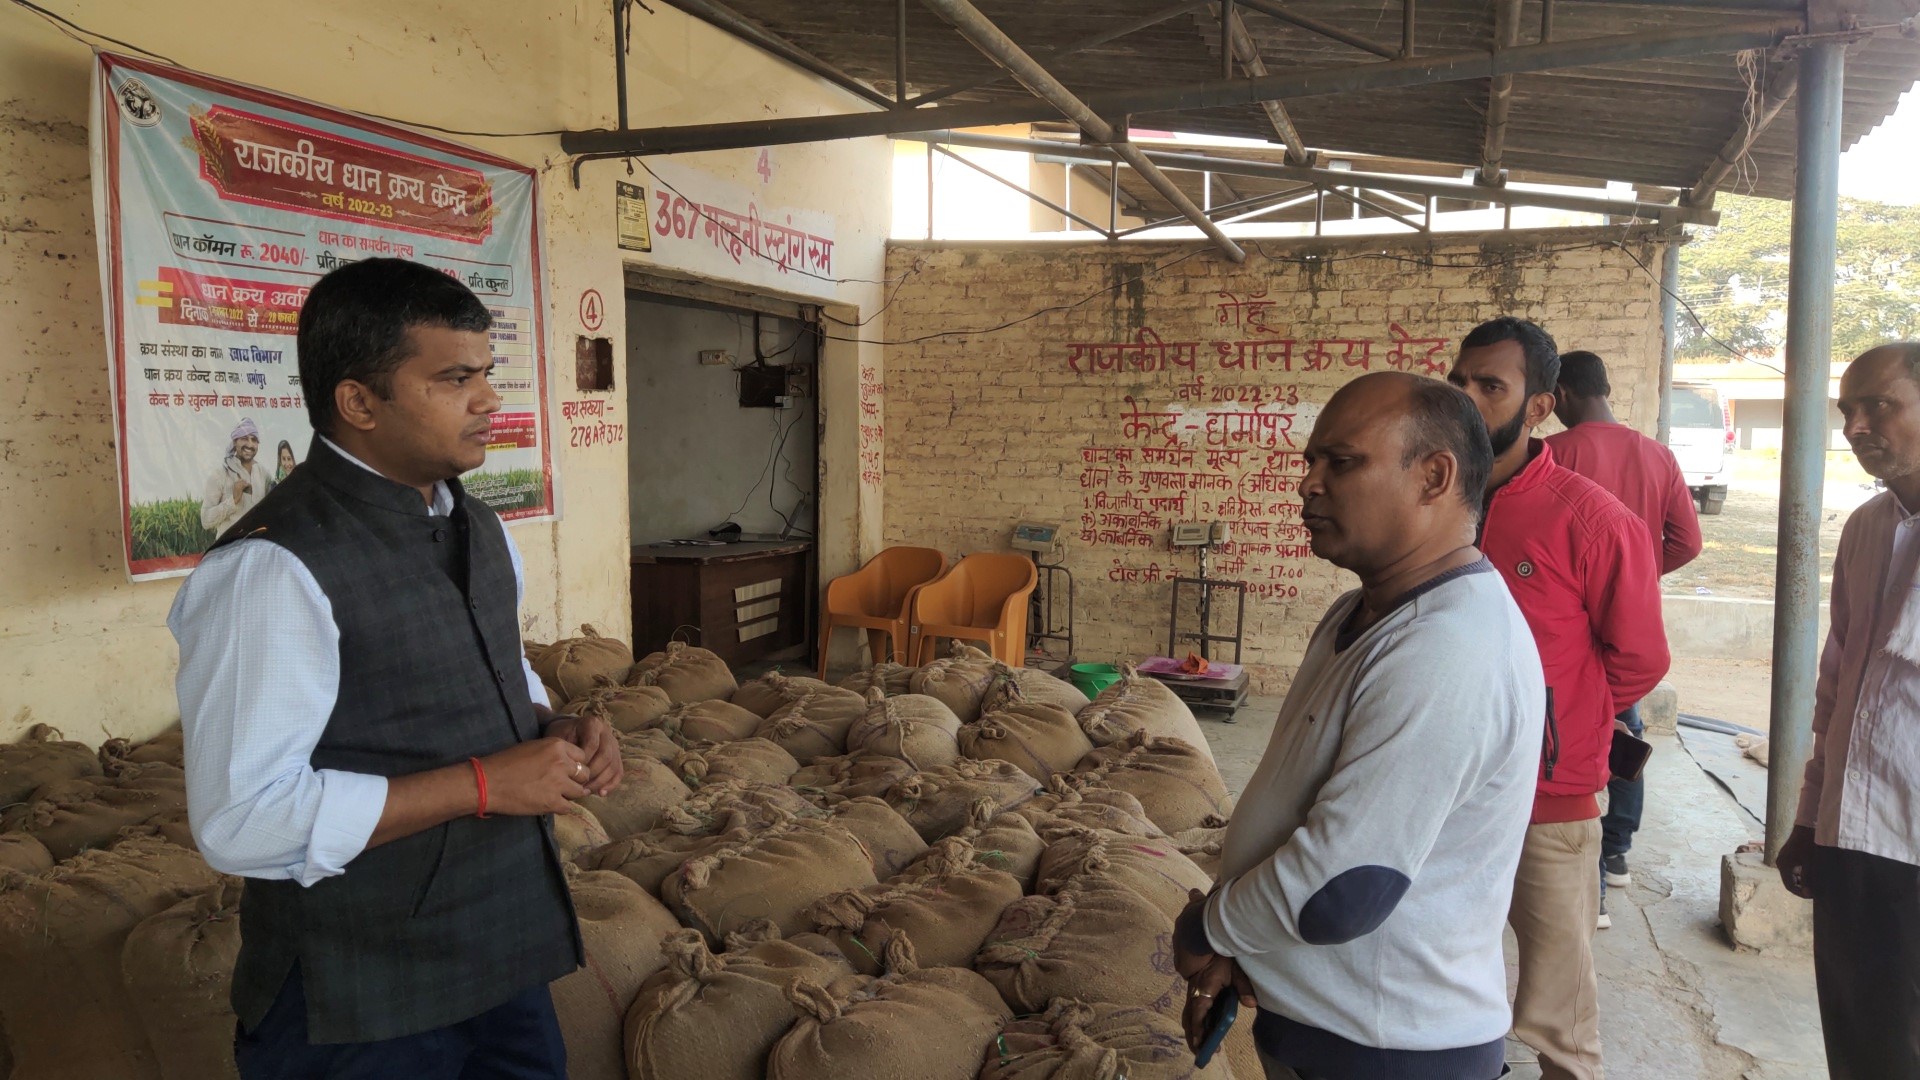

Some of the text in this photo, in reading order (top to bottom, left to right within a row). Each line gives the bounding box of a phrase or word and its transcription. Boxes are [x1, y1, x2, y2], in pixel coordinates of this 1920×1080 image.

[234, 140, 468, 216] राजकीय धान क्रय केन्द्र
[757, 148, 771, 184] 4
[322, 191, 393, 218] वर्ष 2022-23
[318, 231, 414, 258] धान का समर्थन मूल्य
[655, 190, 701, 240] 367
[763, 214, 807, 274] स्ट्रांग
[808, 234, 835, 276] रूम
[193, 234, 236, 257] कॉमन
[260, 243, 310, 267] 2040/-
[316, 251, 337, 270] प्रति
[201, 282, 228, 300] धान
[232, 286, 266, 304] क्रय
[468, 272, 484, 290] प्रति
[180, 297, 208, 322] दिनांक
[247, 308, 259, 328] से
[586, 296, 598, 324] 4
[140, 342, 158, 357] क्रय
[161, 340, 188, 358] संस्था
[192, 345, 207, 358] का
[228, 347, 250, 362] खाद्य
[250, 344, 283, 364] विभाग
[1066, 326, 1201, 374] राजकीय
[1208, 338, 1298, 372] धान
[1301, 339, 1376, 372] क्रय
[144, 368, 161, 382] धान
[164, 370, 183, 382] क्रय
[186, 364, 212, 384] केन्द्र
[214, 370, 228, 384] का
[246, 369, 268, 390] धर्मापुर
[149, 389, 170, 408] केन्द्र
[174, 389, 184, 406] के
[188, 390, 218, 412] खुलने
[222, 394, 236, 408] का
[237, 395, 254, 409] समय
[270, 398, 278, 409] 09
[280, 392, 292, 408] बजे
[294, 392, 301, 408] से
[1212, 385, 1299, 405] 2022-23
[562, 402, 579, 424] बूथ
[1120, 395, 1184, 448] केन्द्र
[1206, 404, 1297, 450] धर्मापुर
[598, 420, 606, 446] से
[607, 424, 623, 444] 372
[1083, 448, 1112, 463] धान
[1114, 447, 1134, 462] का
[1141, 442, 1198, 468] समर्थन
[1206, 450, 1248, 472] मूल्य
[1080, 466, 1114, 489] धान
[1117, 464, 1134, 486] के
[1189, 472, 1233, 490] मानक
[1084, 496, 1092, 510] 1.
[1148, 490, 1190, 516] पदार्थ
[1081, 511, 1096, 528] क)
[1142, 562, 1162, 584] फ्री
[1216, 556, 1248, 575] नमी
[1268, 565, 1303, 580] 17.00
